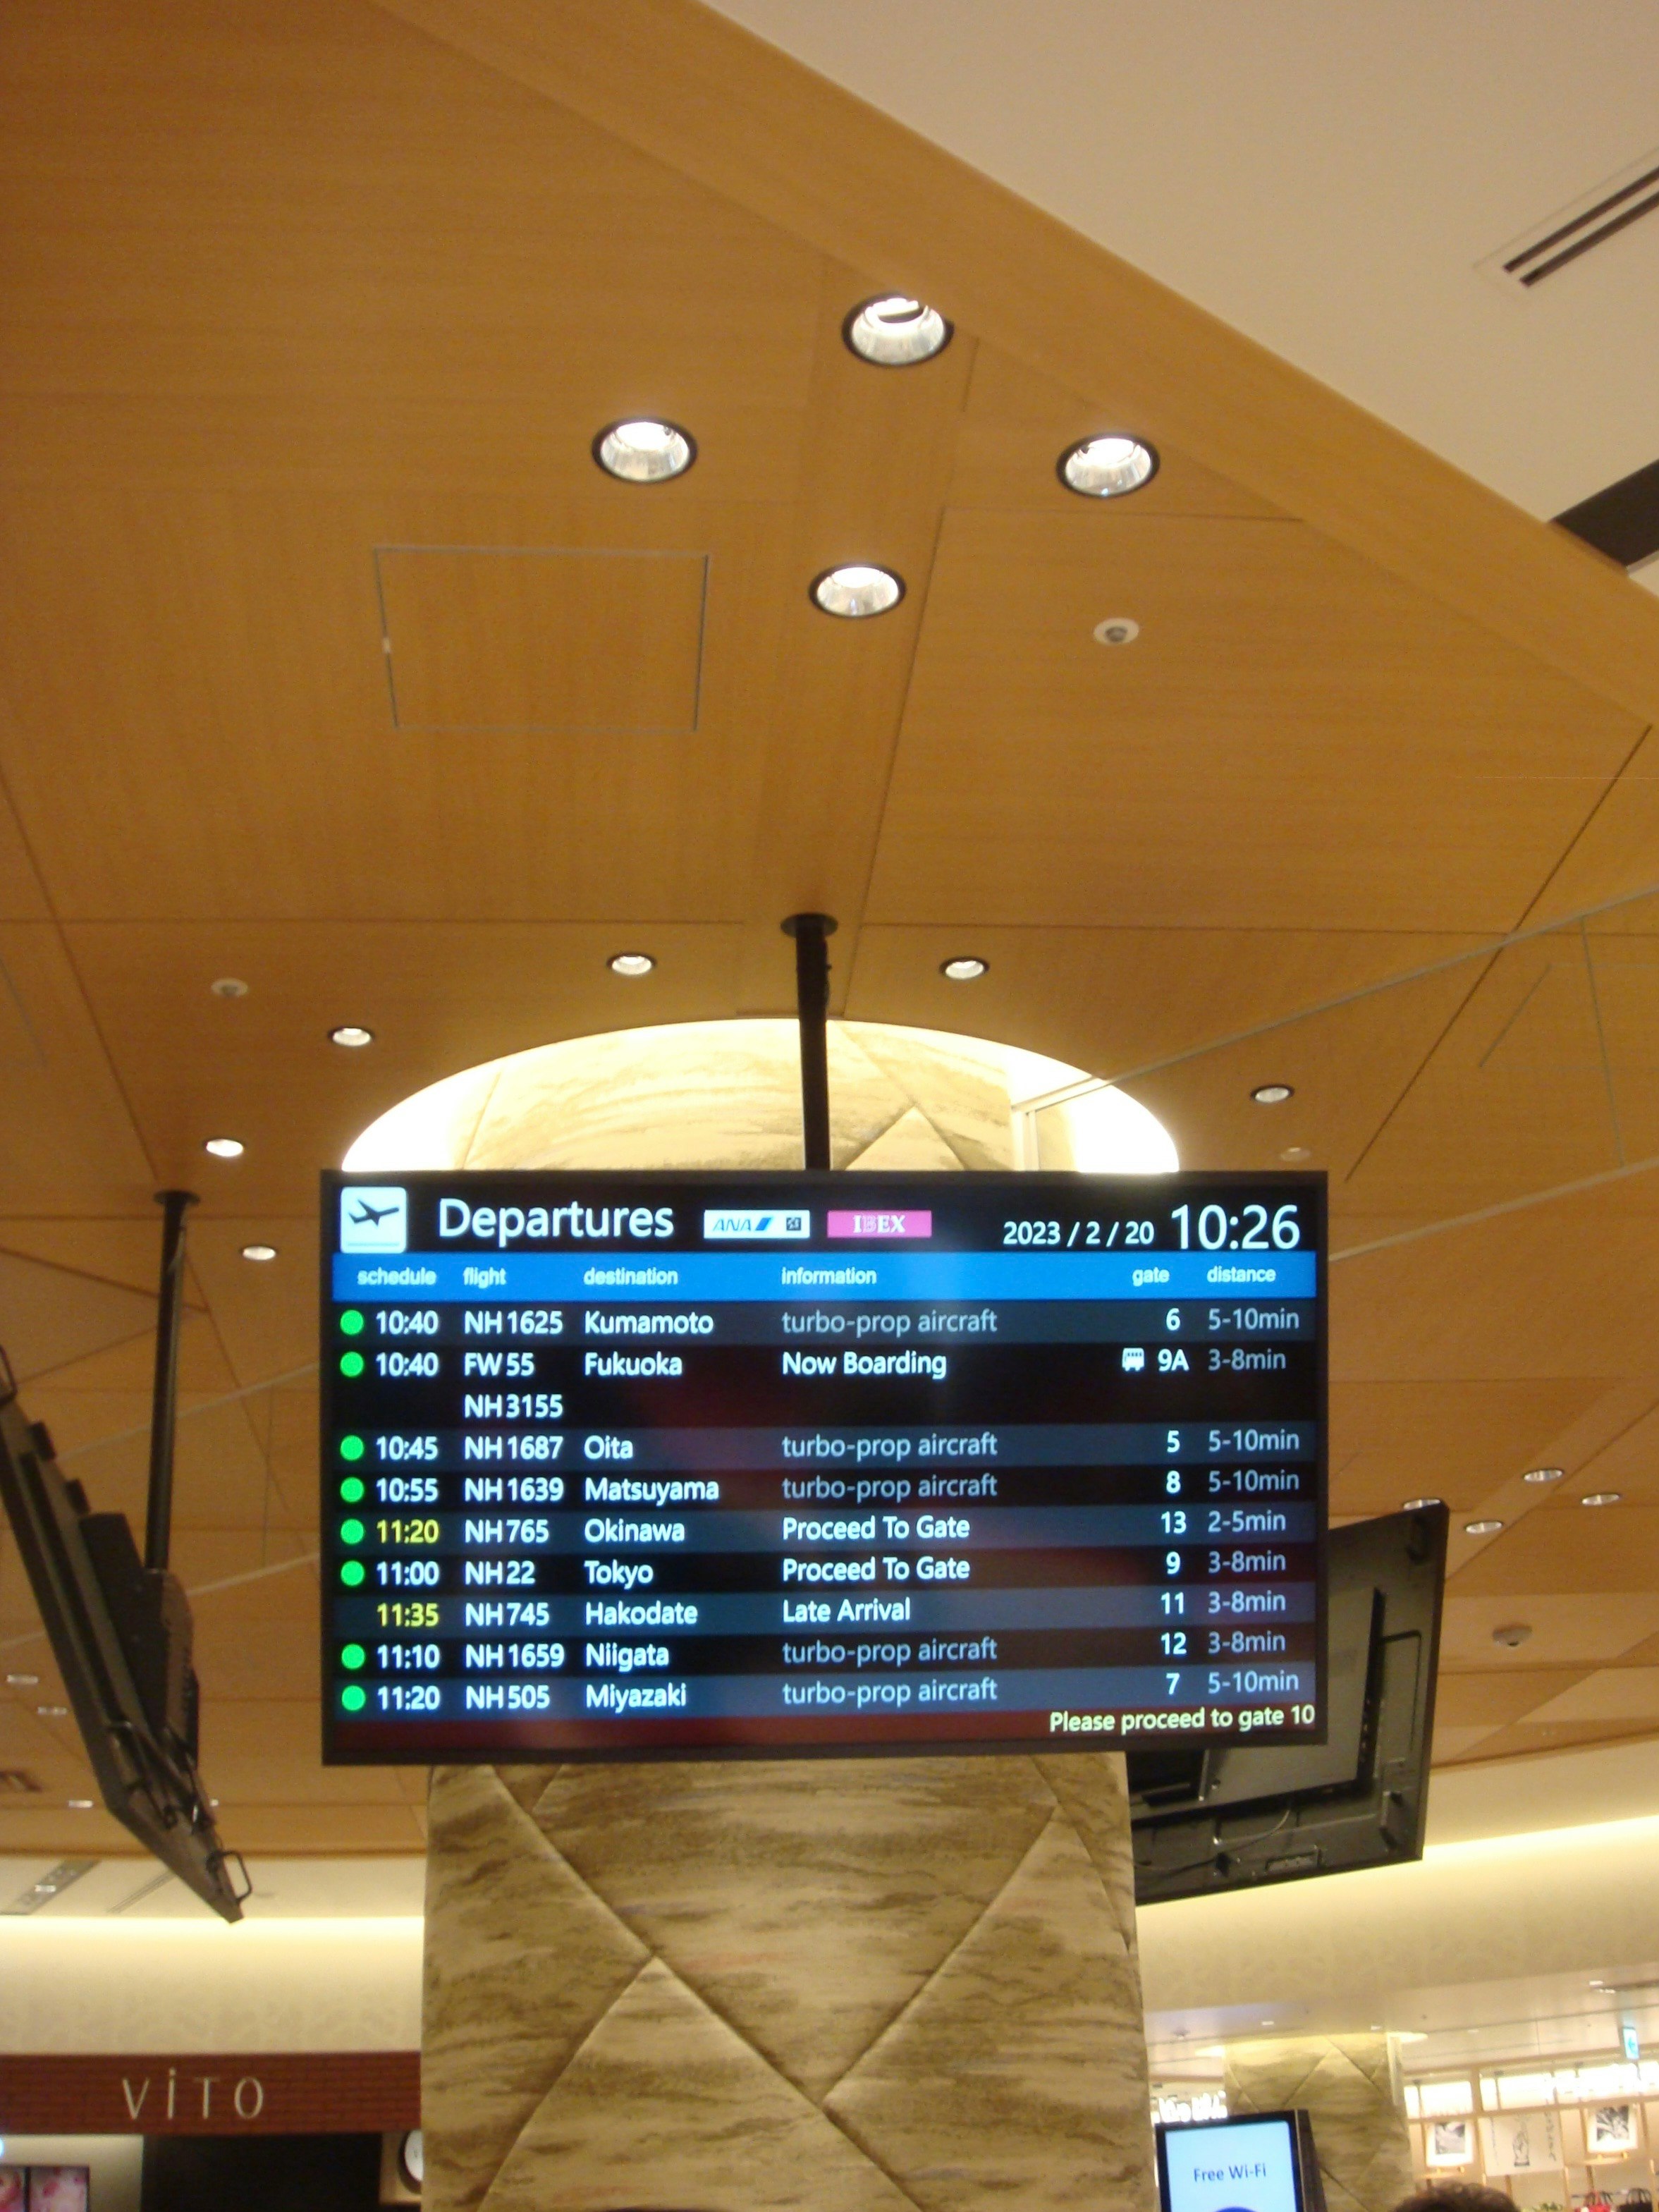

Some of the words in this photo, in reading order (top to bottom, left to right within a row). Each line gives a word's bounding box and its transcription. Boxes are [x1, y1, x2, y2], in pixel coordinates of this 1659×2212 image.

[439, 1199, 673, 1248] Departures
[711, 1217, 752, 1232] ANA
[852, 1215, 907, 1234] IBEX
[1172, 1204, 1300, 1250] 10:26
[357, 1267, 437, 1285] schedule
[463, 1267, 506, 1288] flight
[584, 1267, 678, 1285] destination
[782, 1267, 876, 1284] information
[1132, 1267, 1170, 1286] gate
[1207, 1266, 1276, 1282] distance
[377, 1310, 439, 1335] 10:40
[585, 1311, 714, 1335] Kumamoto
[782, 1310, 910, 1338] turbo-prop
[918, 1309, 997, 1332] aircraft
[1166, 1308, 1180, 1331] 6
[1209, 1308, 1299, 1330] 5-10min
[376, 1352, 439, 1376] 10:40
[584, 1351, 682, 1376] Fukuoka
[783, 1352, 837, 1375] Now
[843, 1350, 946, 1380] Boarding
[1158, 1349, 1189, 1371] 9A
[1209, 1349, 1285, 1371] 3-8min
[376, 1436, 438, 1461] 10:45
[584, 1436, 633, 1460] Oita
[782, 1434, 911, 1462] turbo-prop
[919, 1432, 997, 1456] aircraft
[1168, 1431, 1180, 1453] 5
[1209, 1429, 1299, 1452] 5-10min
[377, 1478, 438, 1503] 10:55
[585, 1477, 719, 1507] Matsuyama
[782, 1475, 910, 1503] turbo-prop
[919, 1473, 997, 1497] aircraft
[1166, 1471, 1181, 1494] 8
[1209, 1469, 1299, 1492] 5-10min
[377, 1520, 439, 1543] 11:20
[584, 1518, 685, 1544] Okinawa
[783, 1515, 875, 1541] Proceed
[883, 1516, 910, 1539] To
[917, 1515, 969, 1539] Gate
[1161, 1511, 1187, 1534] 13
[1208, 1510, 1285, 1533] 2-5min
[377, 1561, 439, 1587] 11:00
[783, 1556, 876, 1582] Proceed
[882, 1557, 910, 1581] To
[917, 1556, 970, 1580] Gate
[1166, 1551, 1180, 1575] 9
[1209, 1551, 1285, 1573] 3-8min
[584, 1559, 654, 1590] Tokyo
[584, 1601, 698, 1627] Hakodate
[783, 1600, 831, 1624] Late
[837, 1597, 910, 1622] Arrival
[1161, 1592, 1184, 1615] 11
[1208, 1590, 1285, 1614] 3-8min
[378, 1603, 439, 1627] 11:35
[783, 1640, 911, 1667] turbo-prop
[919, 1637, 997, 1661] aircraft
[1161, 1632, 1187, 1656] 12
[1208, 1631, 1285, 1654] 3-8min
[377, 1644, 440, 1669] 11:10
[584, 1642, 669, 1674] Niigata
[783, 1681, 911, 1709] turbo-prop
[919, 1678, 997, 1702] aircraft
[1166, 1673, 1180, 1696] 7
[1209, 1670, 1299, 1694] 5-10min
[377, 1686, 441, 1712] 11:20
[584, 1682, 686, 1715] Miyazaki
[1051, 1711, 1115, 1732] Please
[1122, 1707, 1204, 1735] proceed
[1211, 1709, 1232, 1727] to
[1238, 1707, 1284, 1731] gate
[1292, 1704, 1314, 1723] 10
[1194, 2169, 1223, 2182] Free
[1229, 2164, 1266, 2179] Wi-Fi
